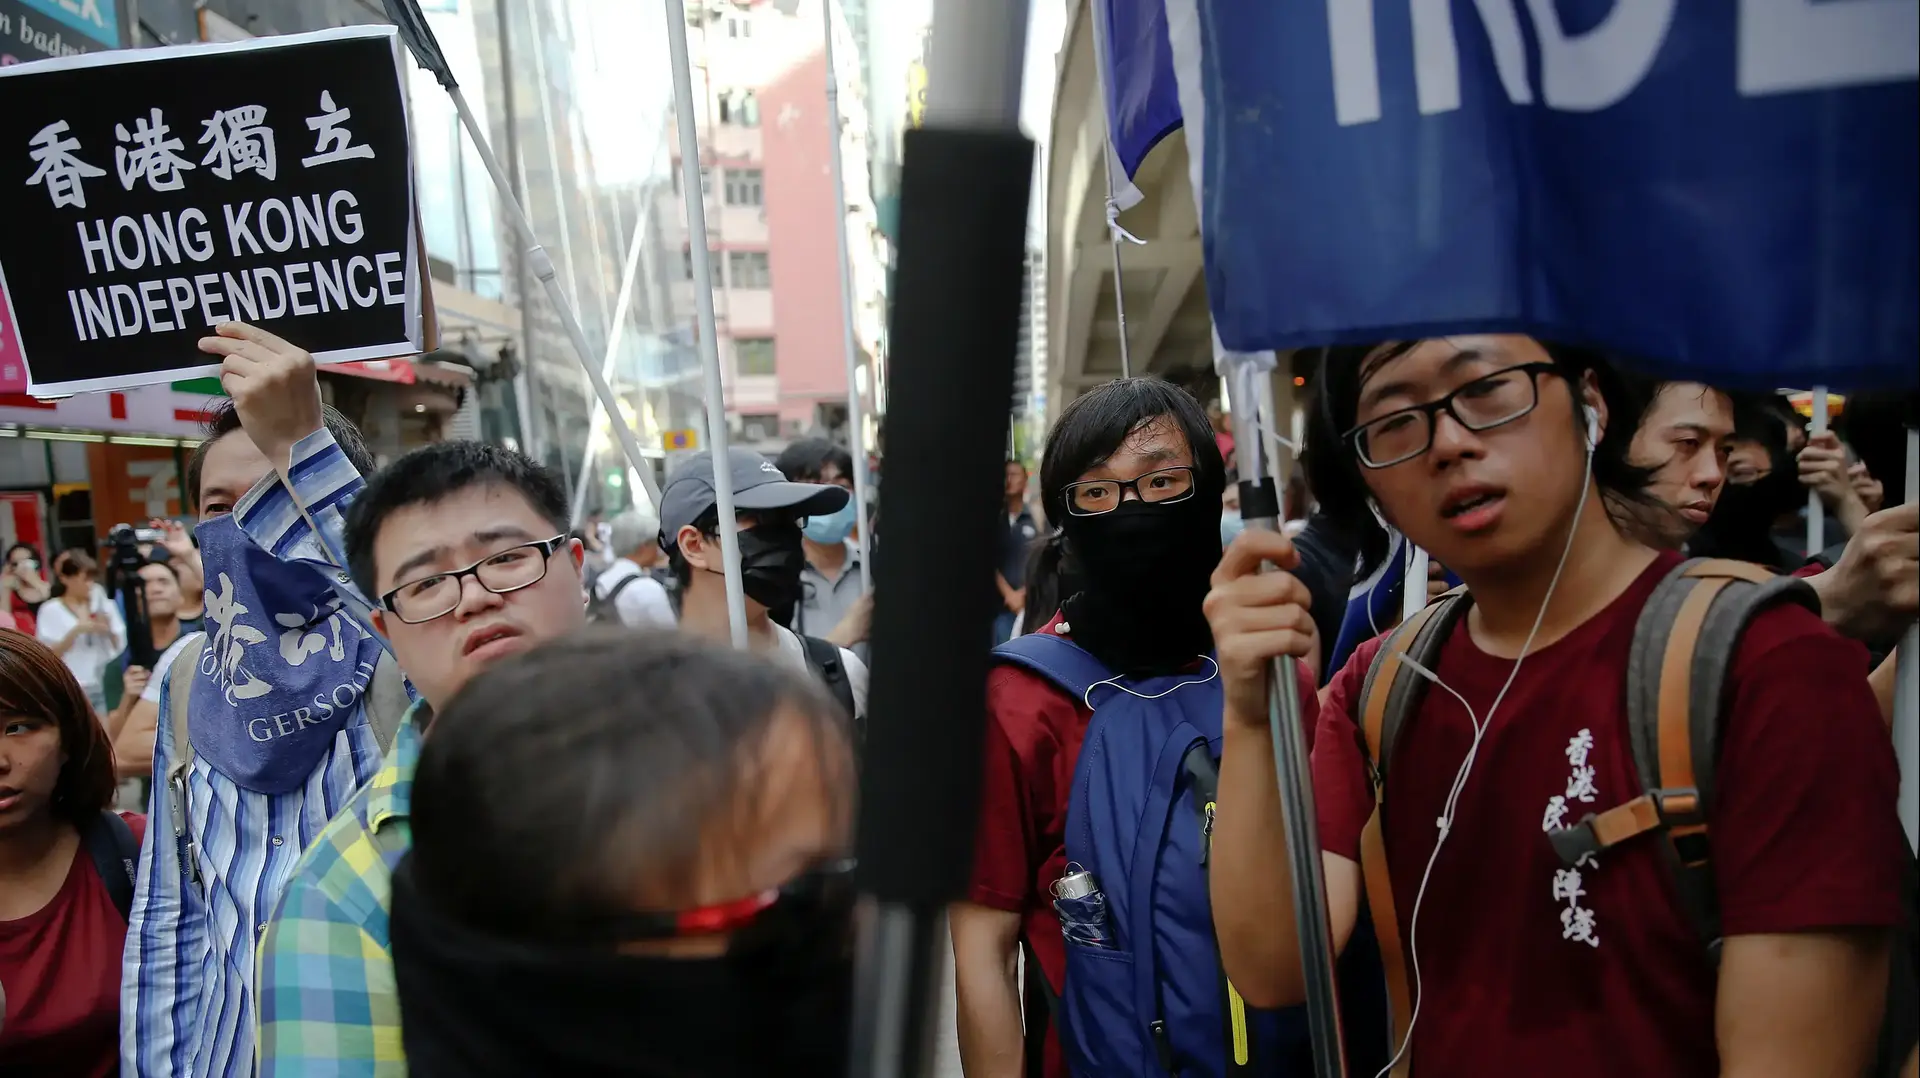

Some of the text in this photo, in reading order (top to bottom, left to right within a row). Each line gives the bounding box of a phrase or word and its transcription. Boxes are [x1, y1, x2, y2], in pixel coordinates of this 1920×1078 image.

[26, 90, 376, 209] 香港獨立
[77, 190, 364, 274] HONG KONG
[68, 252, 406, 341] INDEPENDENCE
